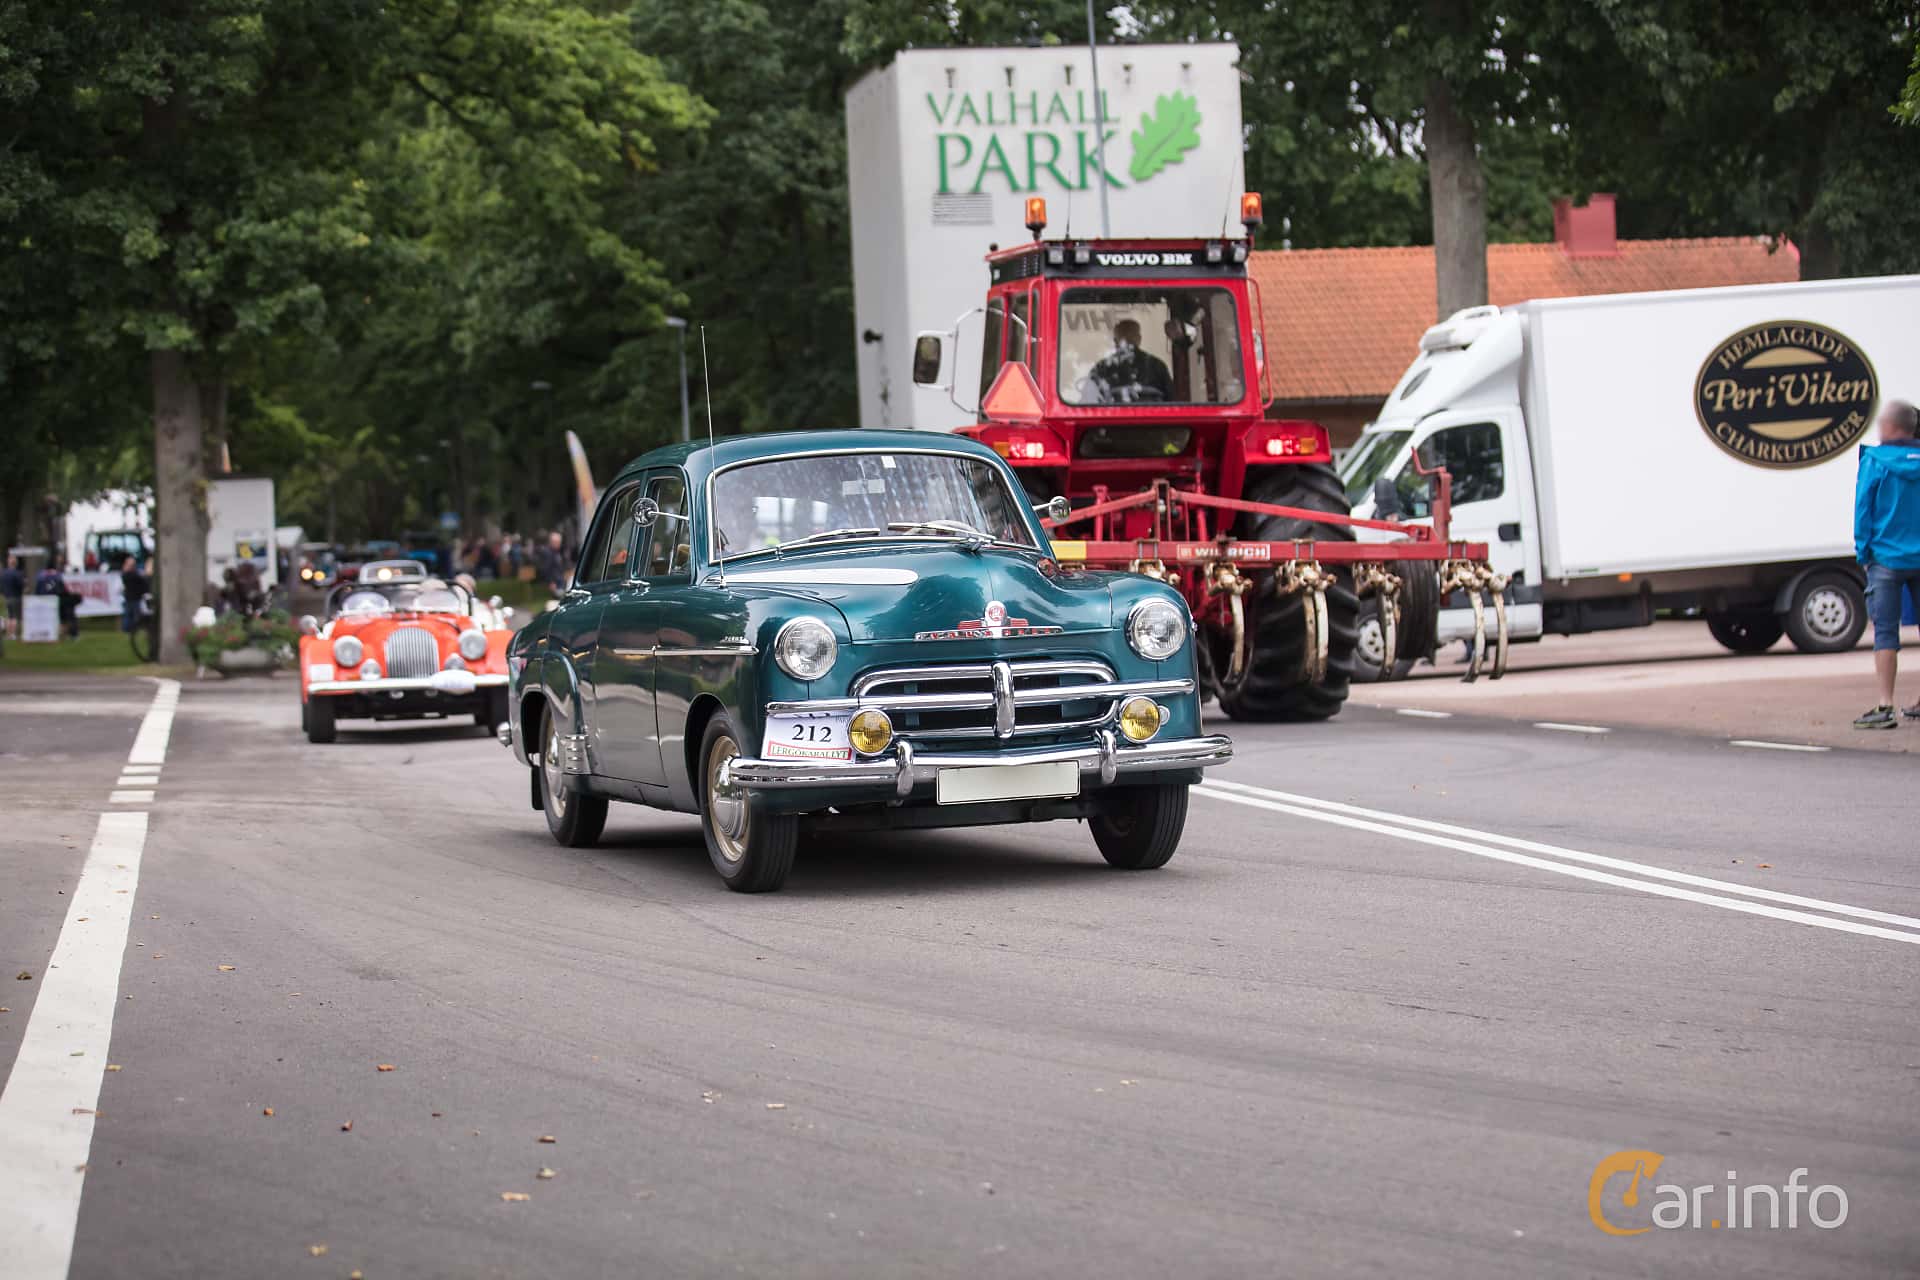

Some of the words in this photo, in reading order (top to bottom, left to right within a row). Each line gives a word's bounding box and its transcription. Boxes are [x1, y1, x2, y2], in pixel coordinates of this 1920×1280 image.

[926, 90, 1121, 126] VALHALL
[935, 129, 1127, 194] PARK
[1096, 253, 1160, 266] VOLVO
[1161, 253, 1193, 266] BM
[1718, 327, 1849, 370] HEMLAGADE
[1704, 378, 1762, 412] Per
[1778, 371, 1871, 406] Viken
[1715, 410, 1866, 462] CHARKUTERIER
[1195, 546, 1267, 557] WILRICH
[791, 723, 832, 743] 212
